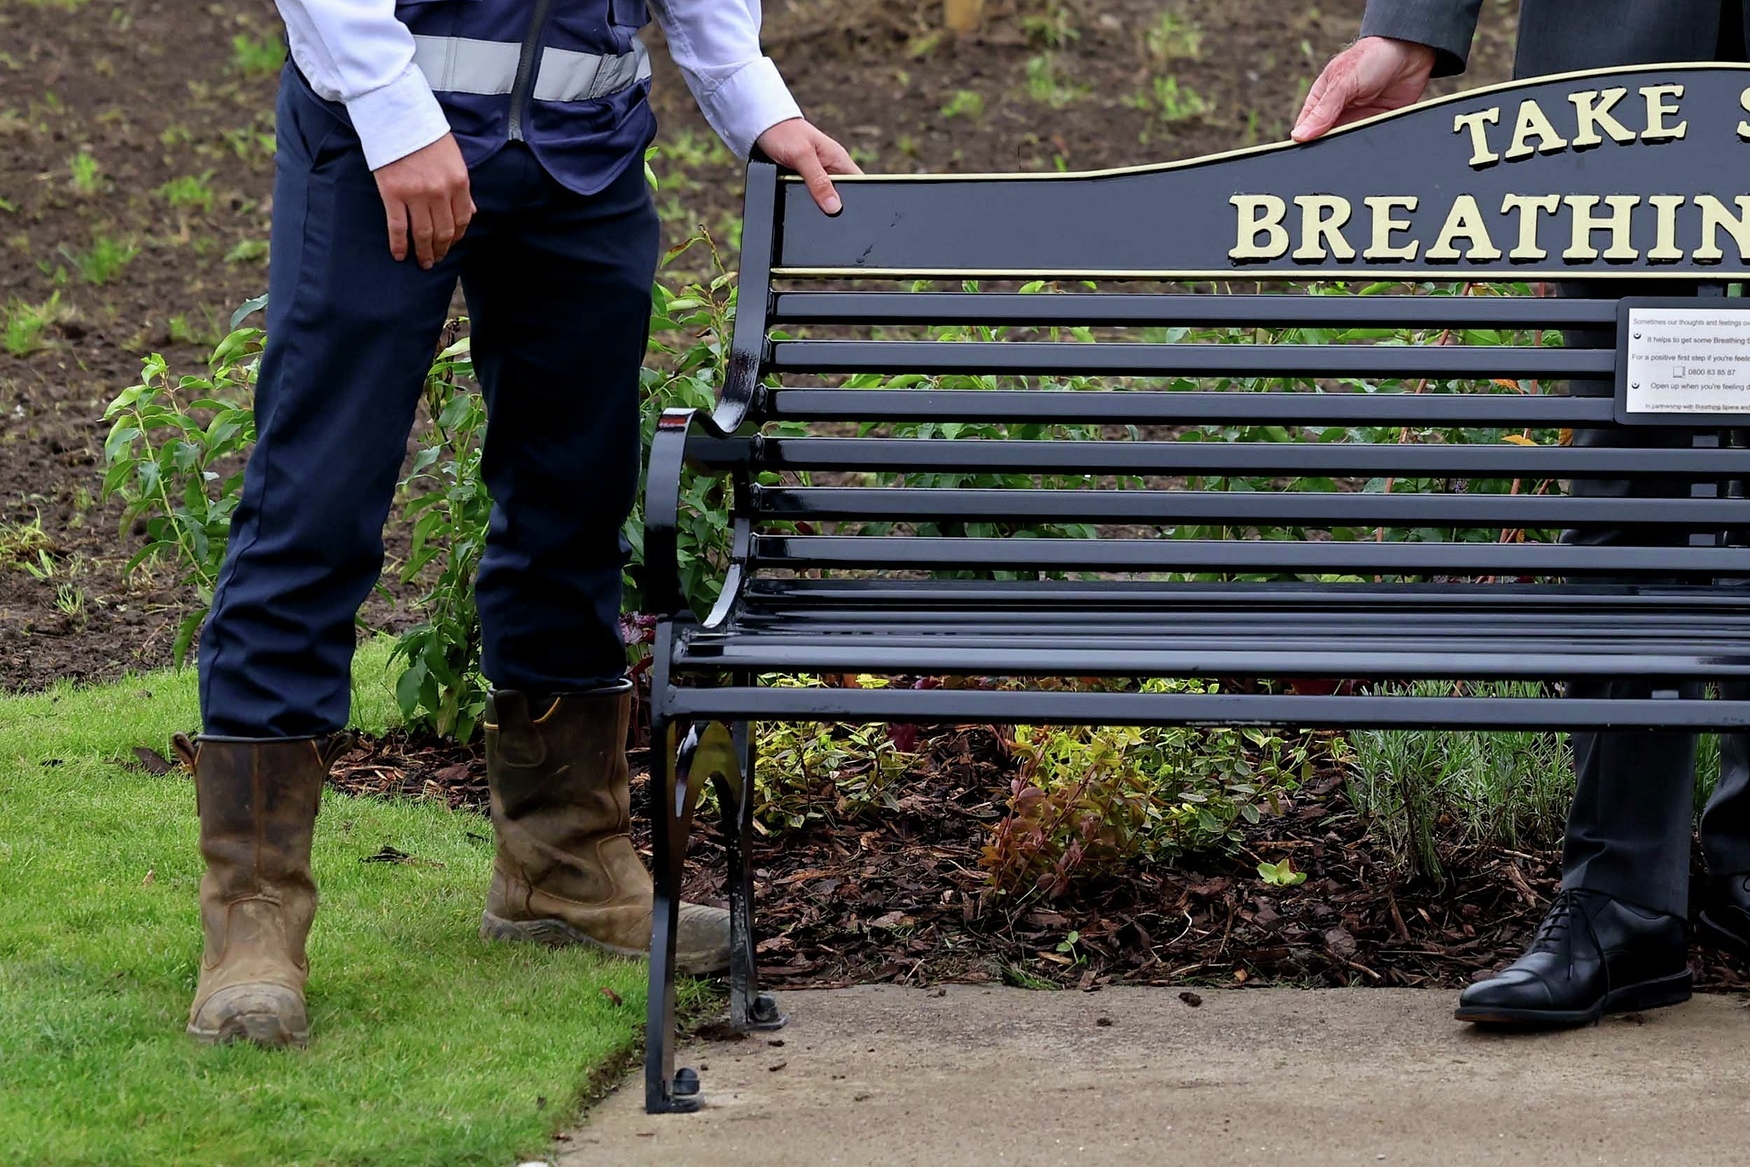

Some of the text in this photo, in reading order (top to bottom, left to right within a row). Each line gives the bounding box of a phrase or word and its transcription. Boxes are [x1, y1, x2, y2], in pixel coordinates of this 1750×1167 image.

[1453, 83, 1690, 168] TAKE
[1679, 319, 1704, 327] thoughts
[1681, 337, 1692, 345] get
[1713, 337, 1746, 345] Breathing
[1650, 354, 1676, 362] positive
[1650, 382, 1669, 390] Open
[1722, 383, 1745, 391] feeling
